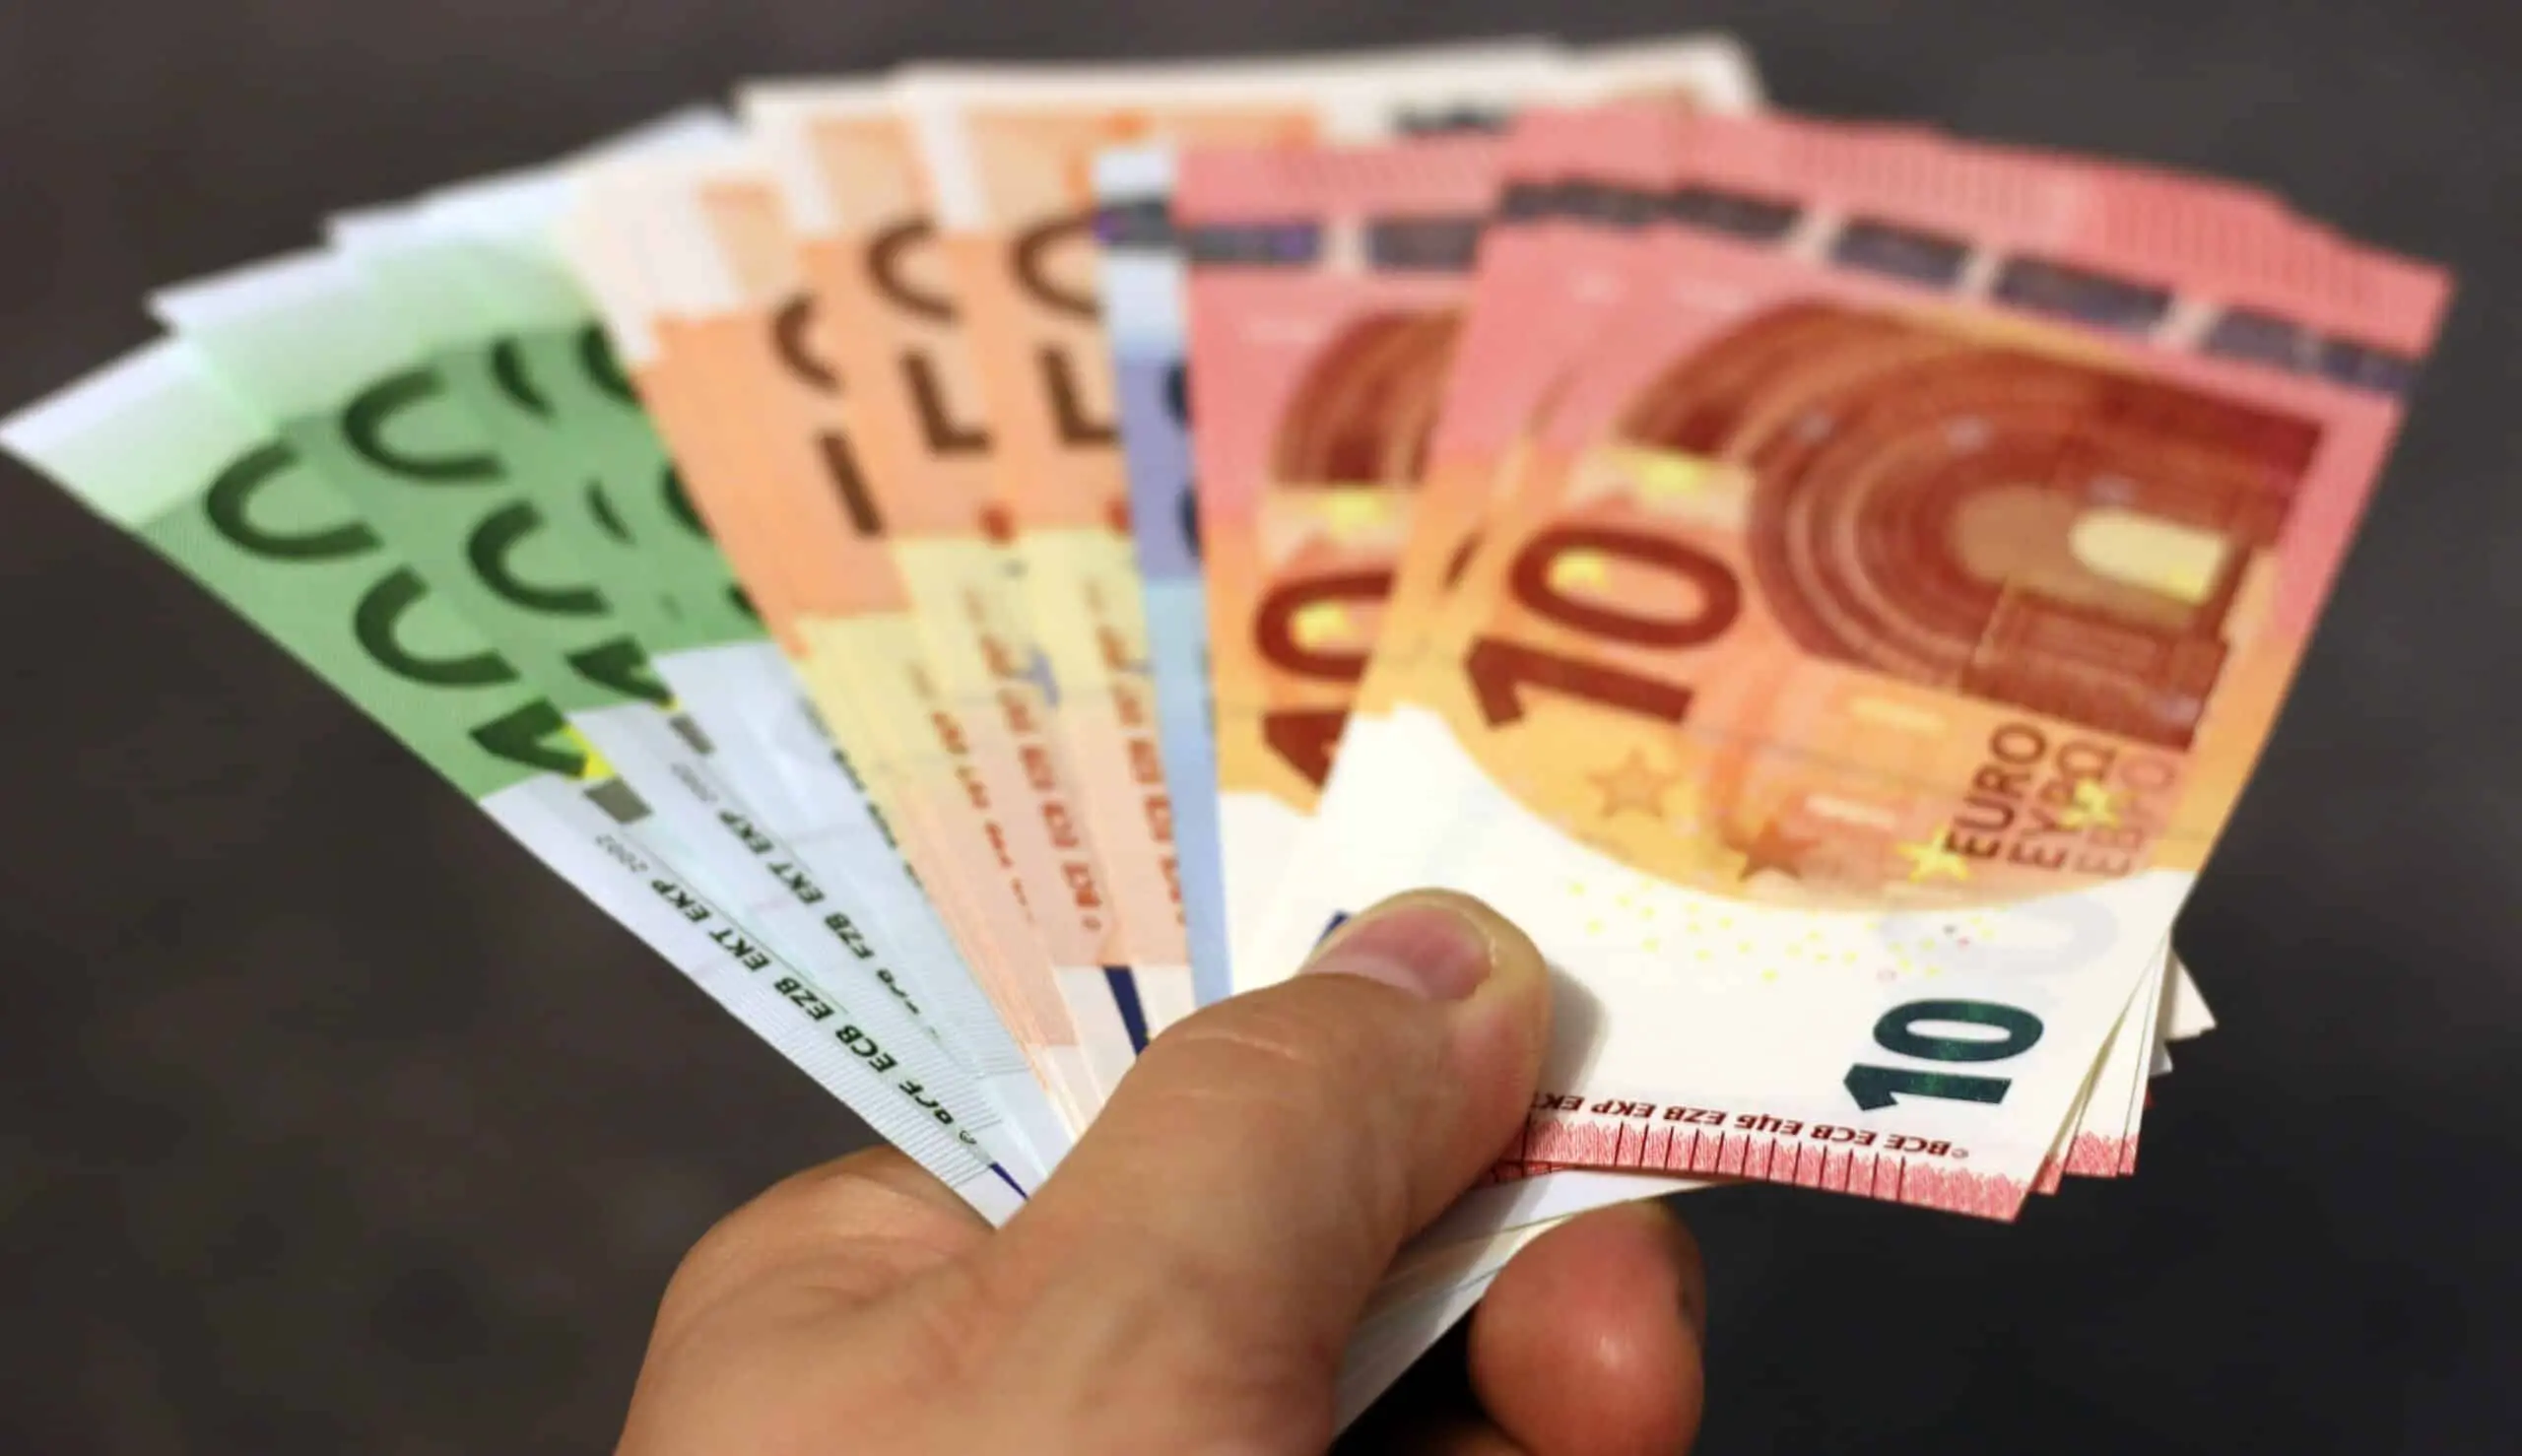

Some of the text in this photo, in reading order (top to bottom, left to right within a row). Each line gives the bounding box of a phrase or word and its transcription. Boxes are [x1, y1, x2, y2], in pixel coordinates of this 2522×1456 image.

[1462, 525, 1743, 731] 10
[1943, 721, 2047, 860] EURO
[718, 810, 774, 855] EKP
[650, 879, 711, 923] EKP
[765, 862, 826, 904] EKT
[707, 928, 772, 972] EKT
[774, 976, 835, 1022] EZB
[834, 1025, 898, 1074] ECB
[1842, 998, 2044, 1112] 10
[1590, 1098, 1657, 1119] EKP
[1662, 1105, 1728, 1126] EZB
[1810, 1123, 1879, 1147] ECB
